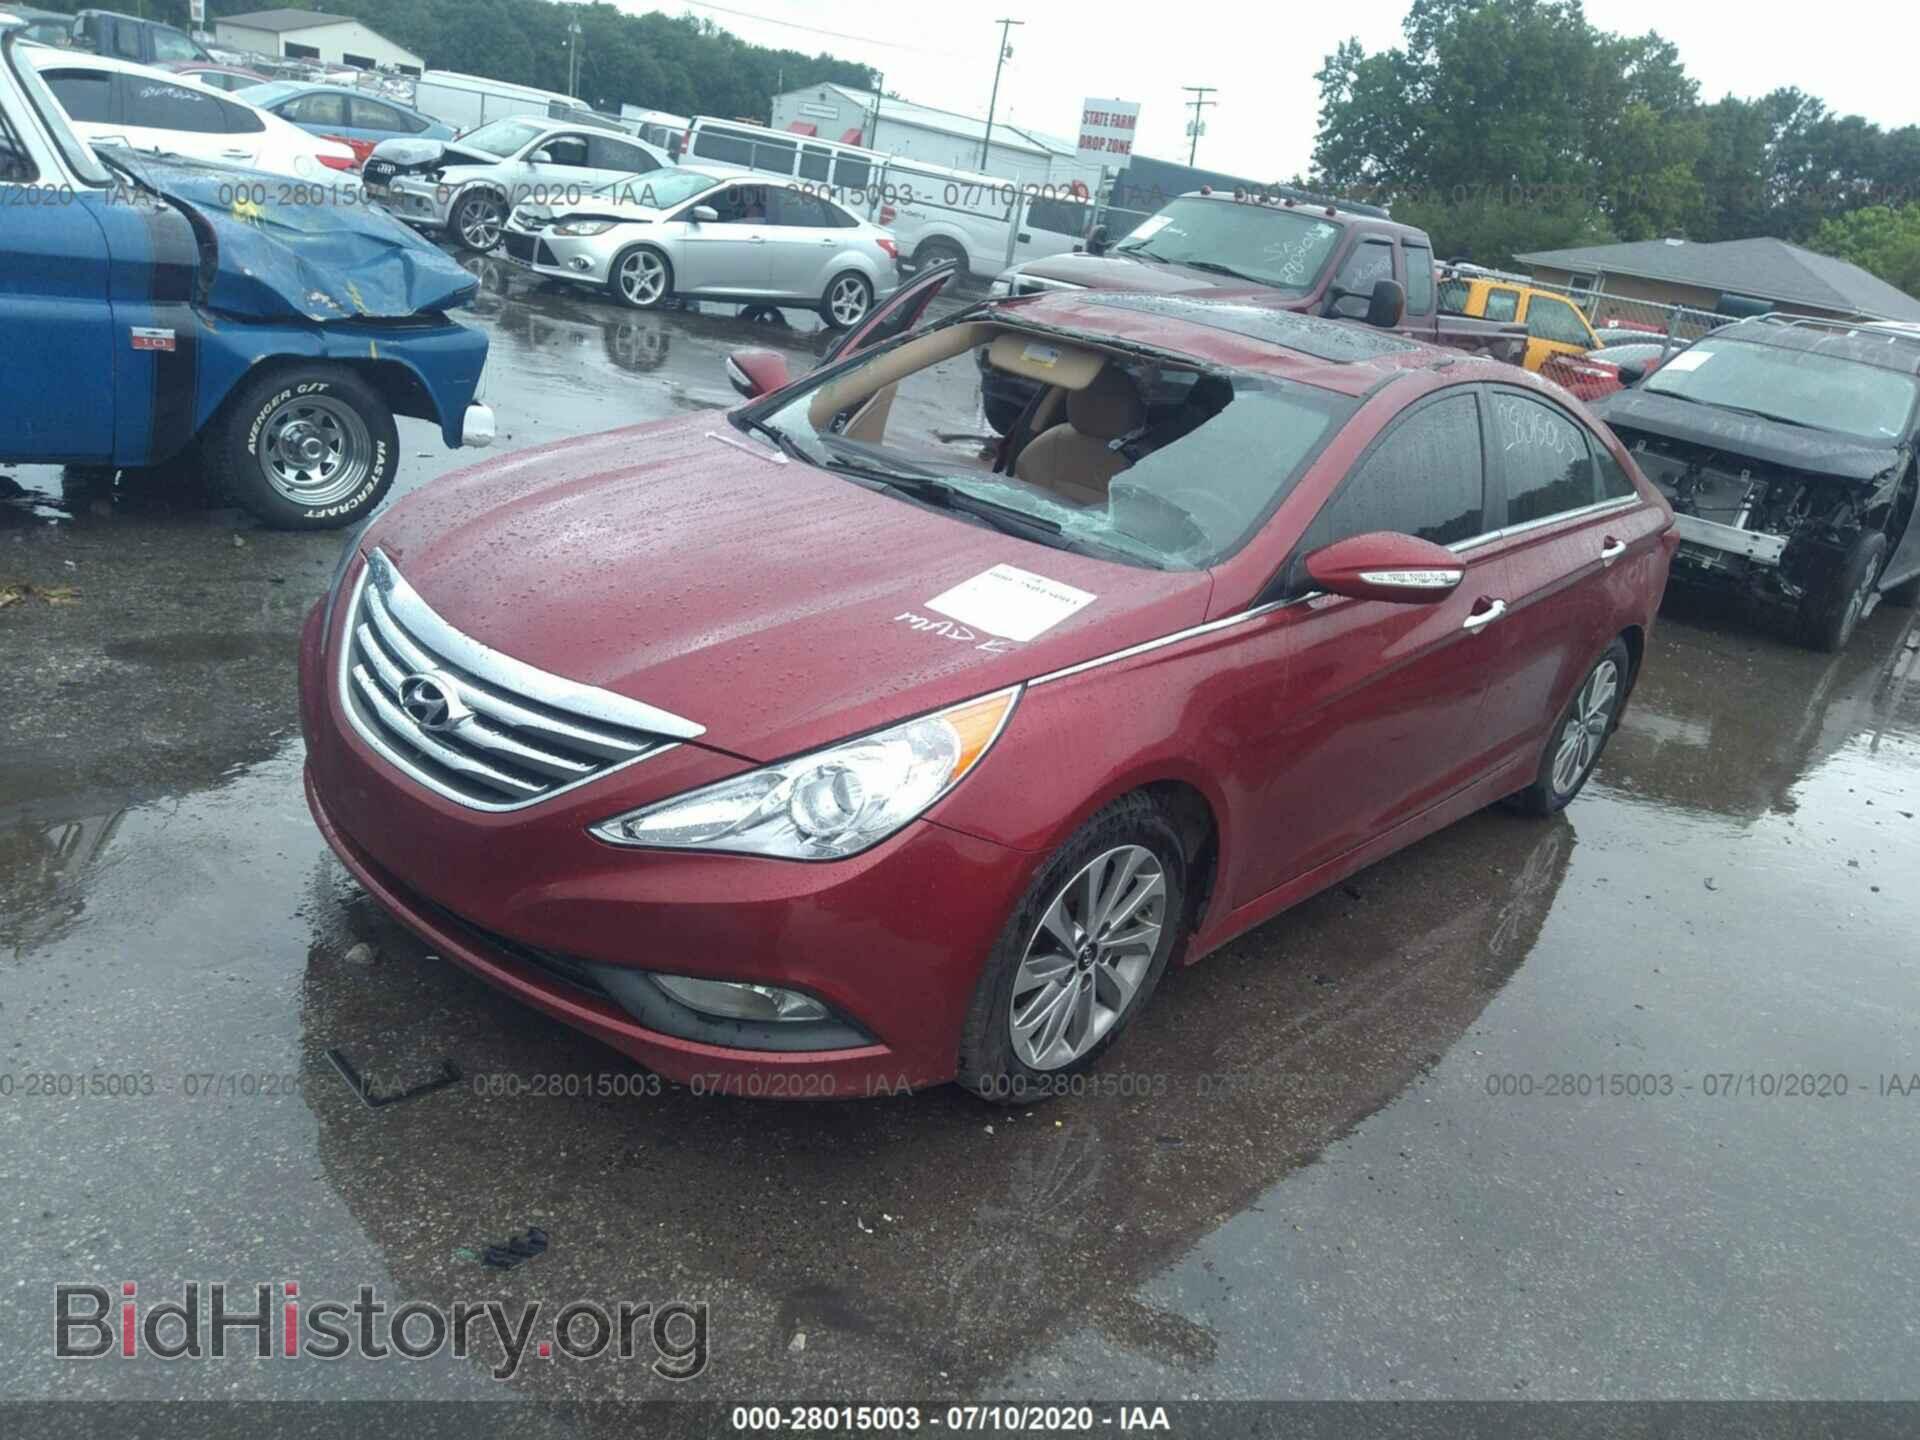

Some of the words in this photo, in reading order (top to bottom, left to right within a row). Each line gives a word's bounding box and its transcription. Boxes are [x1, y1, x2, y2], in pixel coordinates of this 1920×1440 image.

[1082, 110, 1109, 127] STATE
[1110, 113, 1136, 129] FARM
[1079, 134, 1105, 151] DROP
[1105, 138, 1132, 155] ZONE
[247, 389, 292, 456] AVENGER
[297, 382, 330, 394] G/T
[303, 439, 386, 519] MASTERCRAFT
